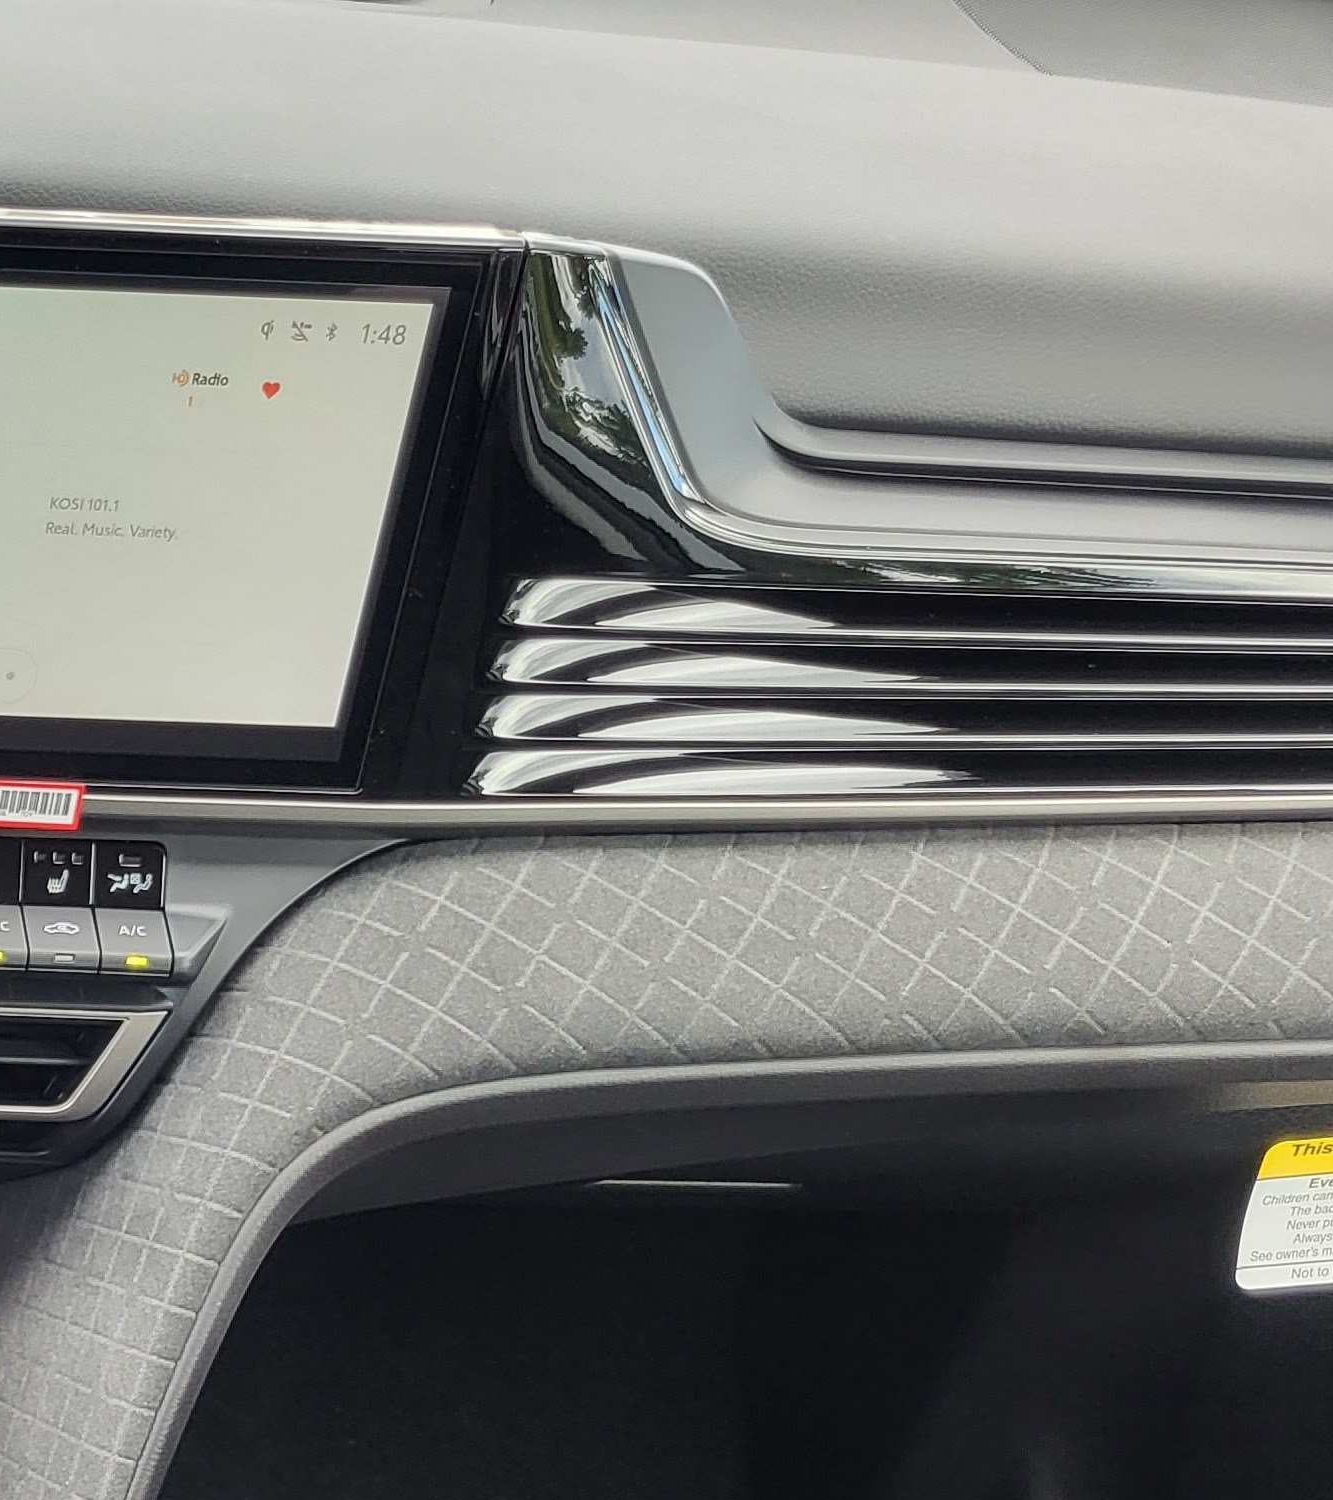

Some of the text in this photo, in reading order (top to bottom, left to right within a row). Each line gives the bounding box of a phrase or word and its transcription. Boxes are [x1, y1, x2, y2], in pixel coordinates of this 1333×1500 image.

[361, 322, 407, 346] 1:48
[192, 372, 229, 386] Radio
[50, 496, 120, 512] KOSI 101.1
[118, 924, 146, 937] A/C
[1292, 1142, 1332, 1157] This
[1262, 1192, 1310, 1206] Children
[1290, 1206, 1312, 1216] The
[1286, 1219, 1320, 1230] Never
[1293, 1232, 1333, 1245] Always
[1250, 1251, 1272, 1262] See
[1276, 1247, 1318, 1260] owner's
[1291, 1266, 1329, 1279] Not to
